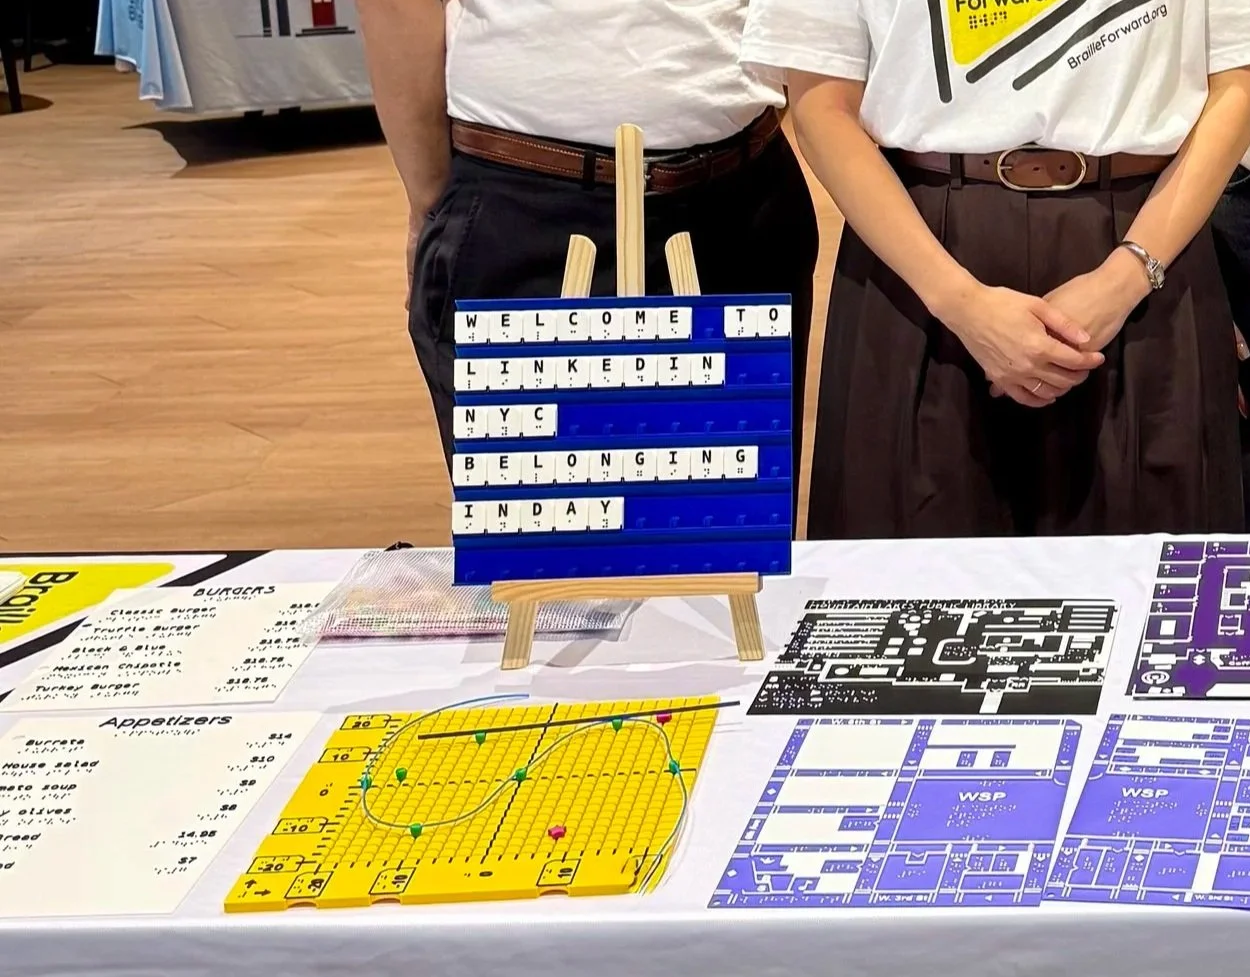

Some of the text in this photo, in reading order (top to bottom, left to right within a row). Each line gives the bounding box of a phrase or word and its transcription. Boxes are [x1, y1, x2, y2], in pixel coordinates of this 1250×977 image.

[1067, 3, 1168, 70] BrailleForward.org
[465, 308, 778, 329] WELCOME TO
[466, 356, 712, 375] LINKEDIN
[465, 407, 544, 423] NYC
[464, 449, 746, 471] BELONGING
[464, 500, 611, 518] INDAY
[169, 606, 217, 614] Burger
[152, 624, 201, 632] Burger
[90, 682, 140, 691] Burger
[98, 714, 233, 732] Appetizers
[354, 720, 372, 728] 20
[332, 753, 350, 761] 10
[958, 790, 1006, 802] WSP
[1120, 787, 1169, 798] WSP
[282, 824, 308, 833] -10
[257, 863, 284, 872] -20
